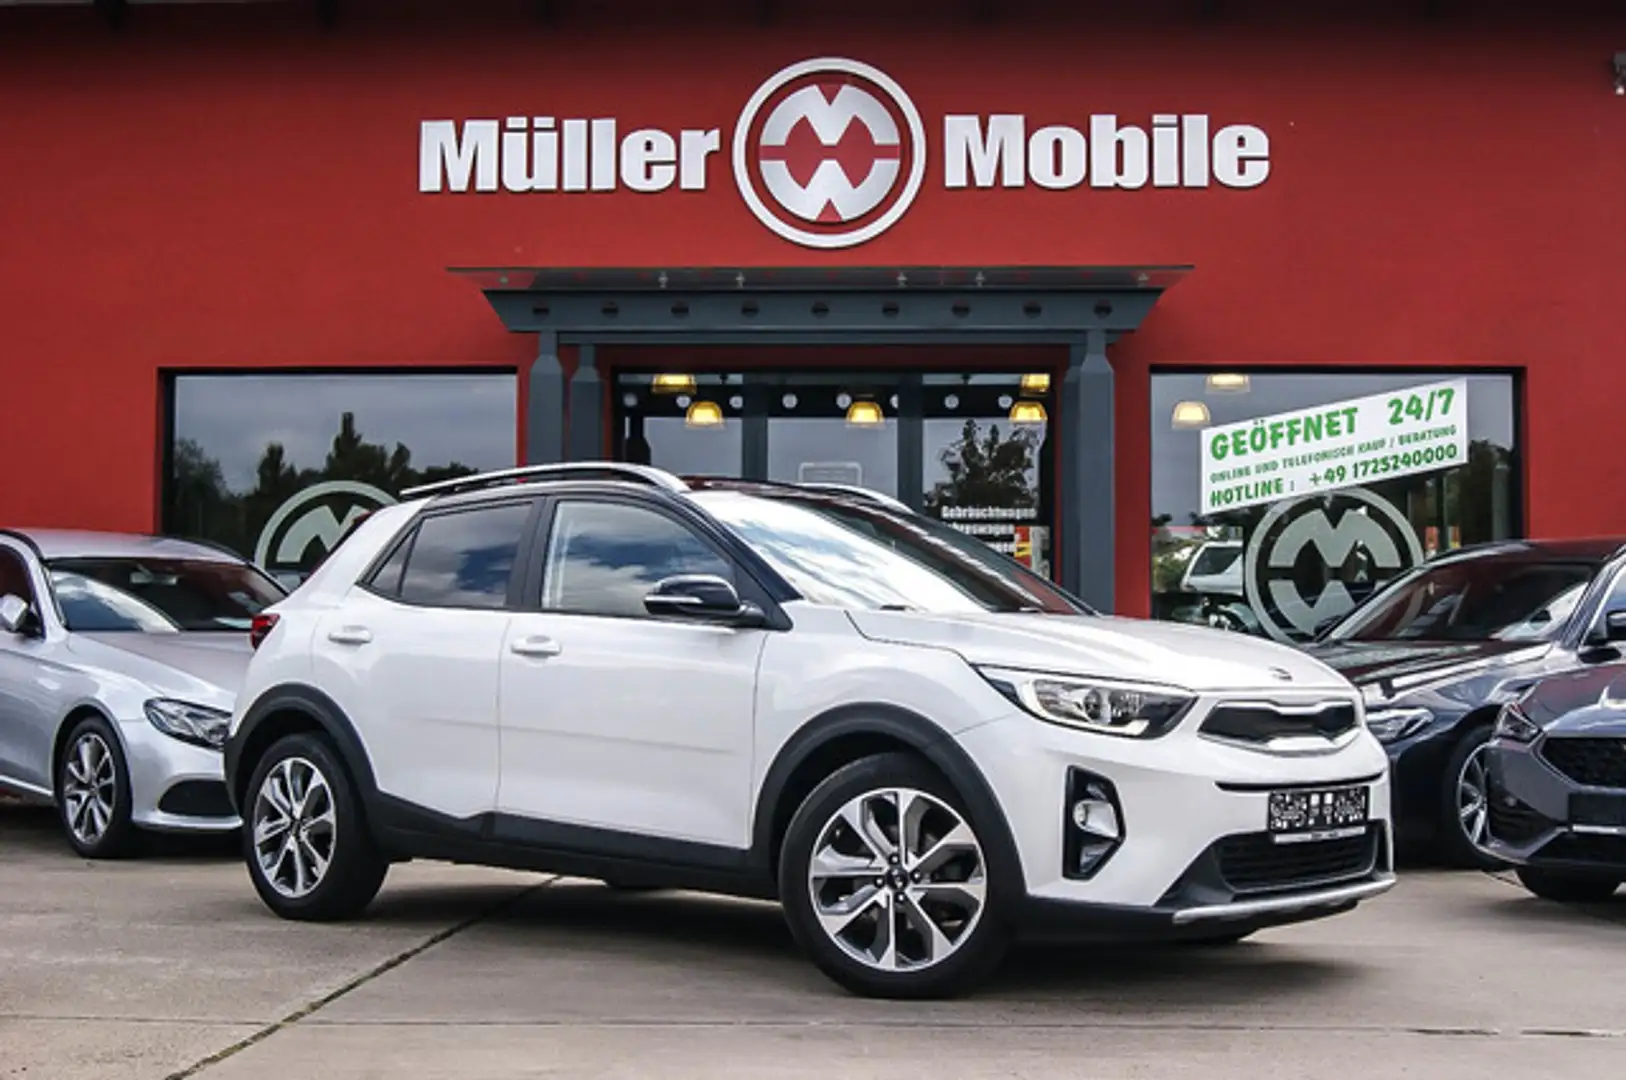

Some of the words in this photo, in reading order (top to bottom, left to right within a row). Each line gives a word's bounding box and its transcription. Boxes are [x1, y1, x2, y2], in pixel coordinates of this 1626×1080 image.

[419, 116, 721, 193] Müller
[944, 114, 1270, 190] Mobile
[1210, 407, 1358, 460] GEÖFFNET
[1388, 387, 1455, 425] 24/7
[1210, 466, 1251, 482] ONLINE
[1255, 460, 1279, 474] UND
[1283, 446, 1355, 469] TELEFONISCH
[1398, 424, 1456, 446] BERATUNG
[1210, 477, 1283, 507] HOTLINE
[1309, 464, 1346, 487] +49
[1352, 443, 1457, 478] 1725240000
